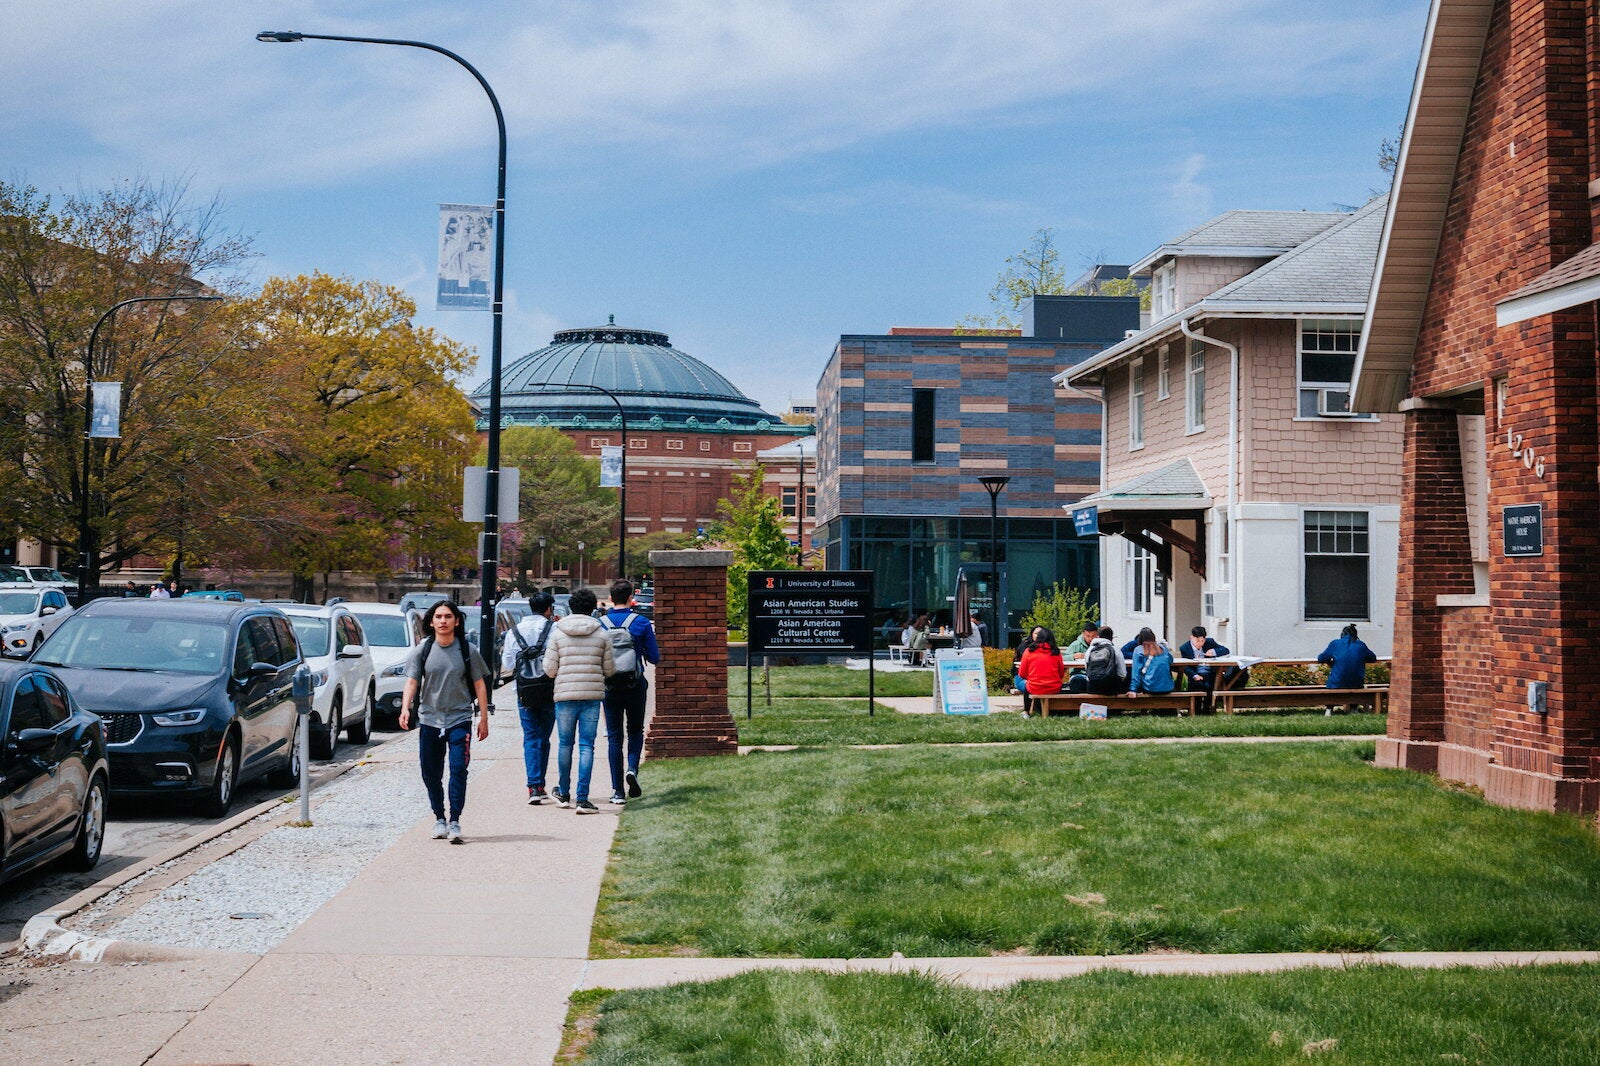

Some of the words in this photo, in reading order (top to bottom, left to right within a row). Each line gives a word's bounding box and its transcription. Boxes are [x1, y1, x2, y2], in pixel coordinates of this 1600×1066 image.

[1507, 427, 1545, 478] 1206
[787, 580, 821, 588] University
[763, 599, 785, 607] Asian
[788, 599, 826, 607] American
[829, 599, 859, 607] Studies
[778, 619, 800, 627] Asian
[803, 619, 841, 627] American
[778, 628, 810, 637] Cultural
[813, 628, 841, 637] Center
